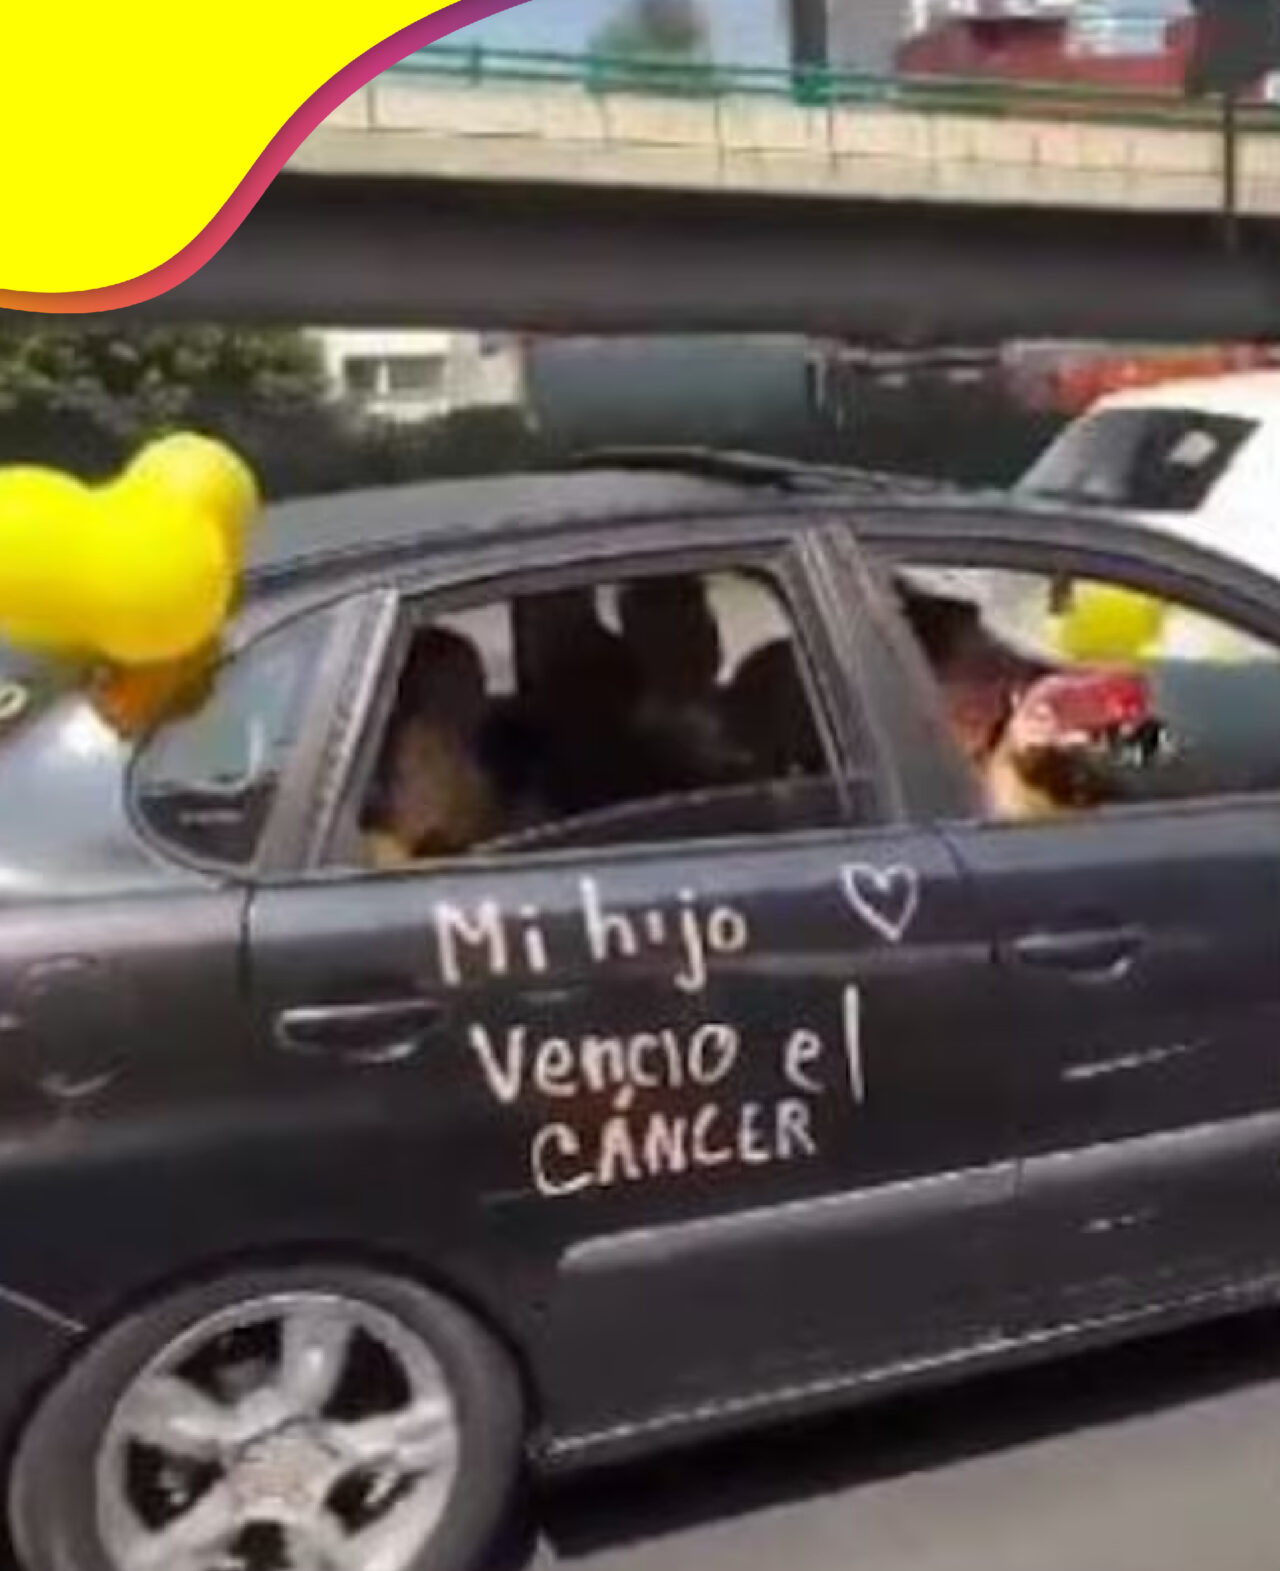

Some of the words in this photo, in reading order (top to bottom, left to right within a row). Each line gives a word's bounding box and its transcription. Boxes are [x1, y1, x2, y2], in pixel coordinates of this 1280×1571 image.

[434, 902, 546, 984] Mi
[580, 874, 749, 992] hijo
[784, 984, 865, 1103] el
[530, 1084, 816, 1197] CÁNCER
